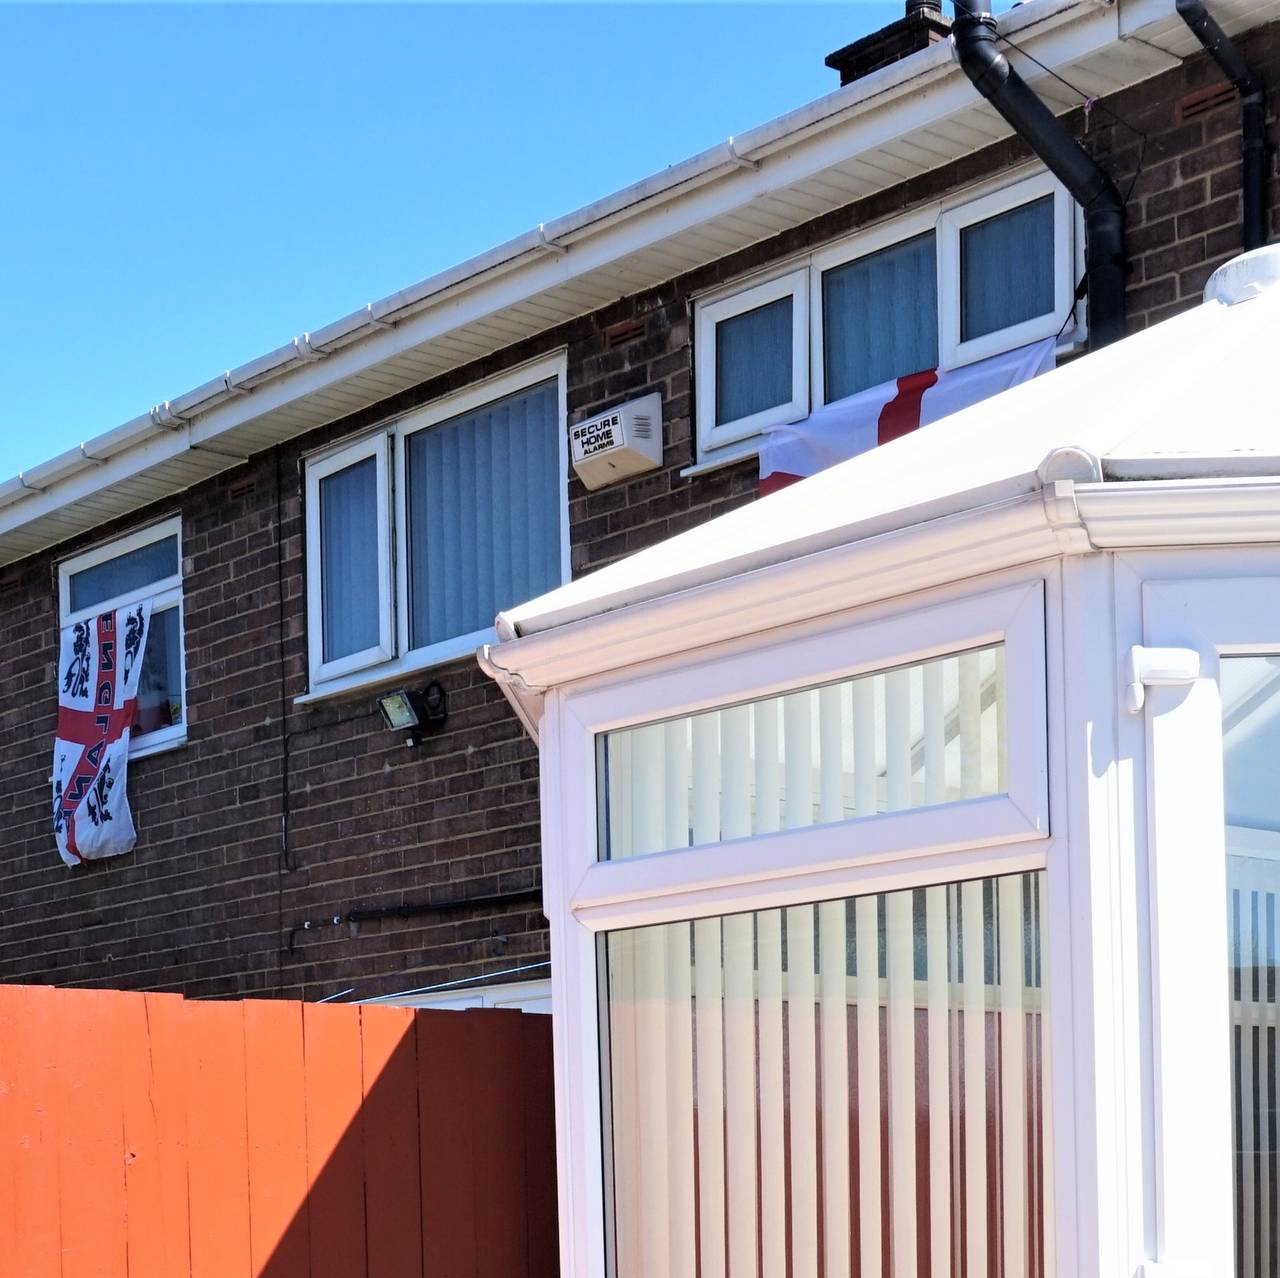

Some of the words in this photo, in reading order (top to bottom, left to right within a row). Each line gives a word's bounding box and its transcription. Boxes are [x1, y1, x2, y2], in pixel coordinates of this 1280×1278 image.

[573, 415, 619, 440] SECURE
[581, 429, 613, 448] HOME
[583, 439, 615, 456] ALARMS
